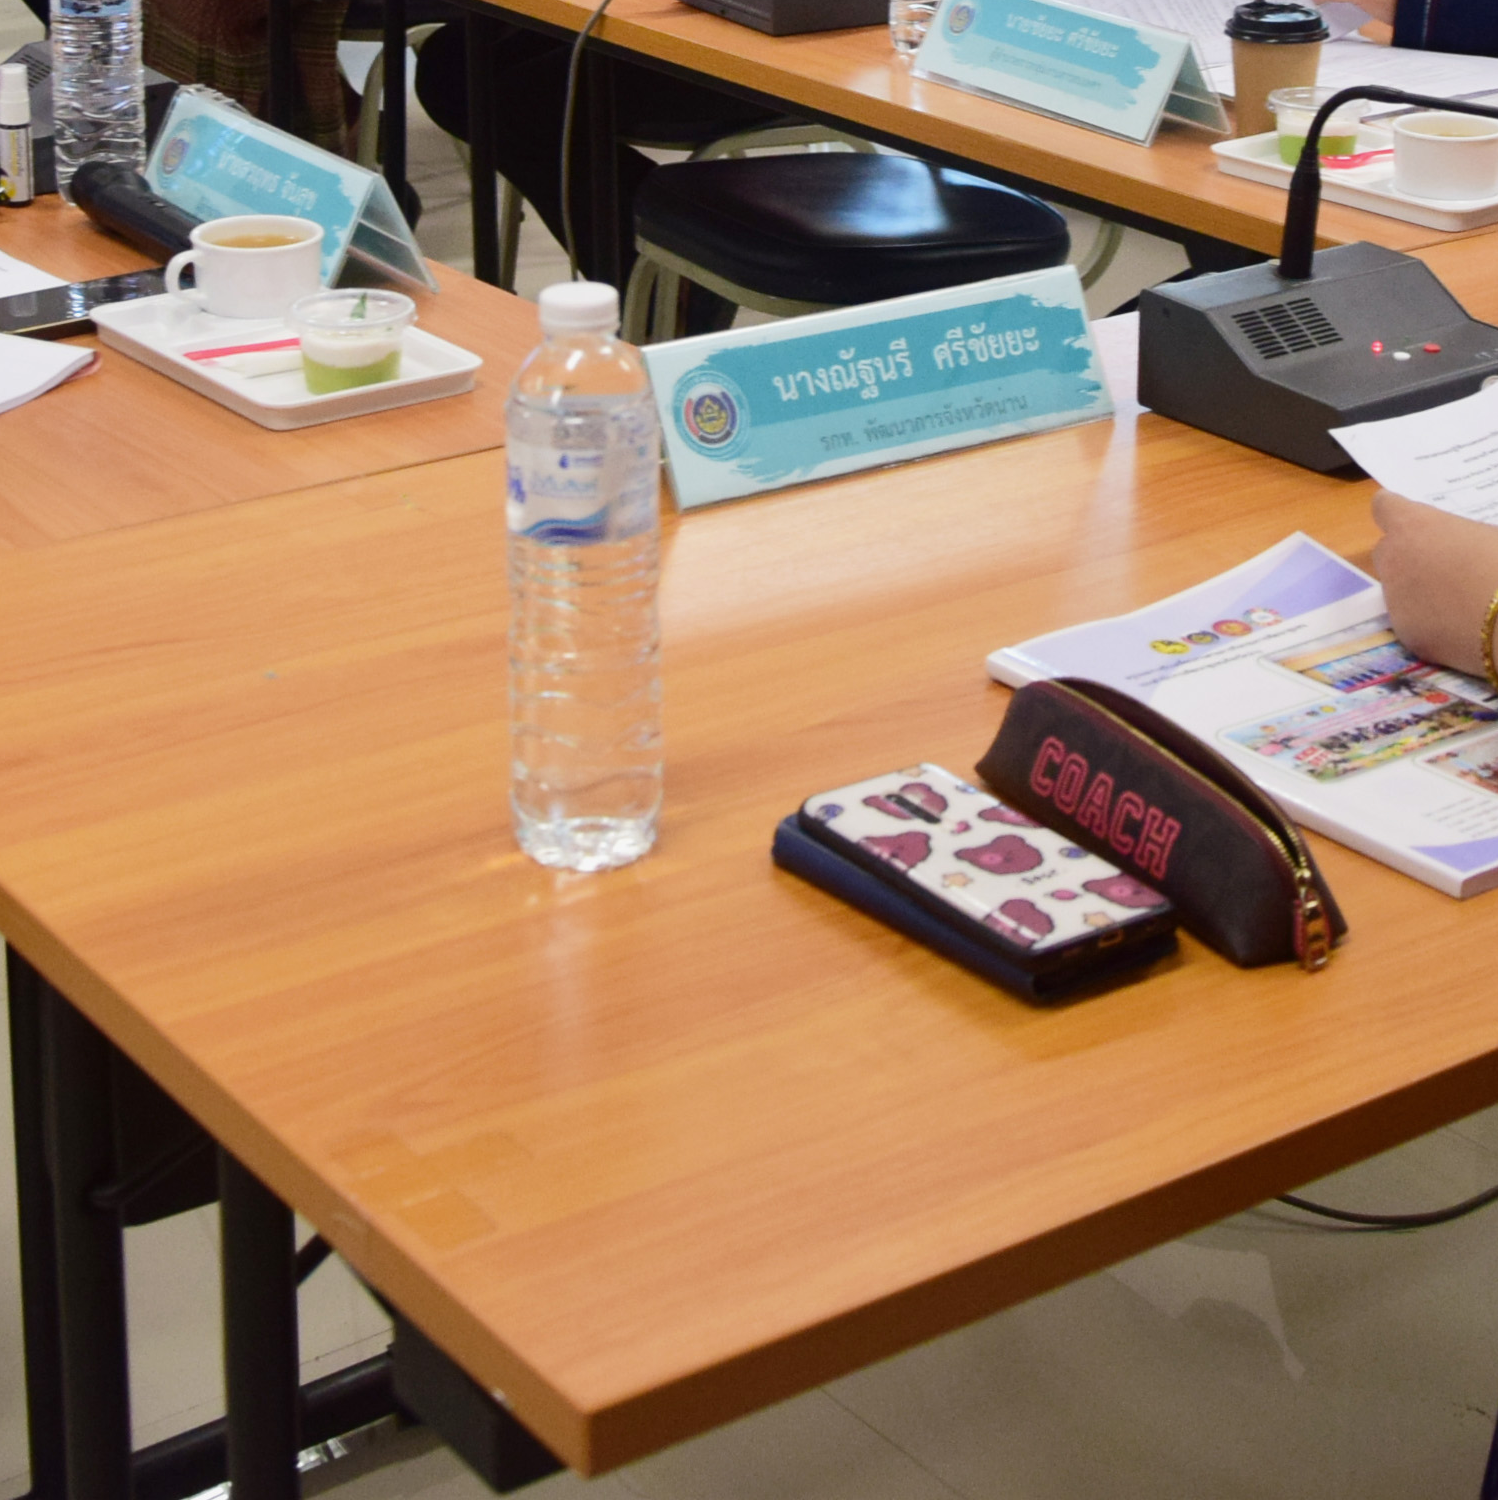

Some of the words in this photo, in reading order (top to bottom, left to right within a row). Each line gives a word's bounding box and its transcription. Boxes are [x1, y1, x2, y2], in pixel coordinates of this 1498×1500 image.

[772, 337, 914, 402] นางณัฐนรี
[931, 320, 1041, 372] ศรีชัยยะ
[863, 386, 1029, 449] พัฒนาการจังหวัดน่าน
[1029, 735, 1182, 882] COACH
